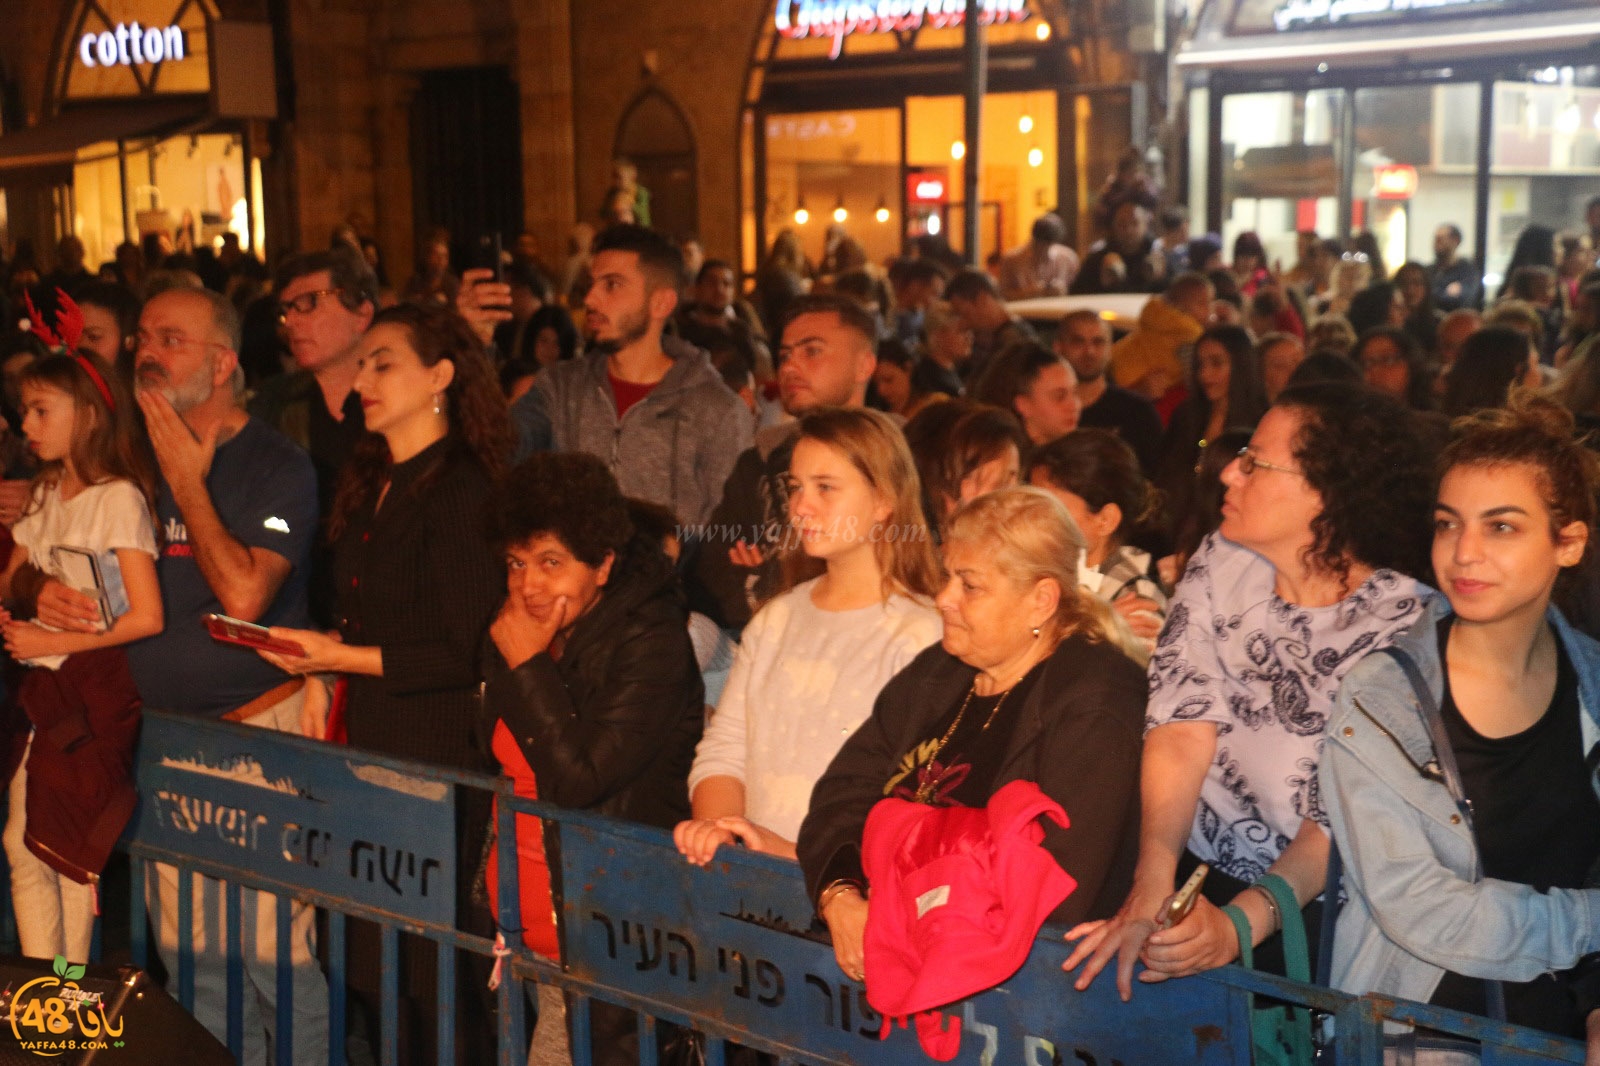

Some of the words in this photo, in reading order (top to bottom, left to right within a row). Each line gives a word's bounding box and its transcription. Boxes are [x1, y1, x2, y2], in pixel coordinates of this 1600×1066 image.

[80, 21, 185, 67] cotton
[591, 911, 697, 982] העיר
[717, 946, 786, 1008] פני
